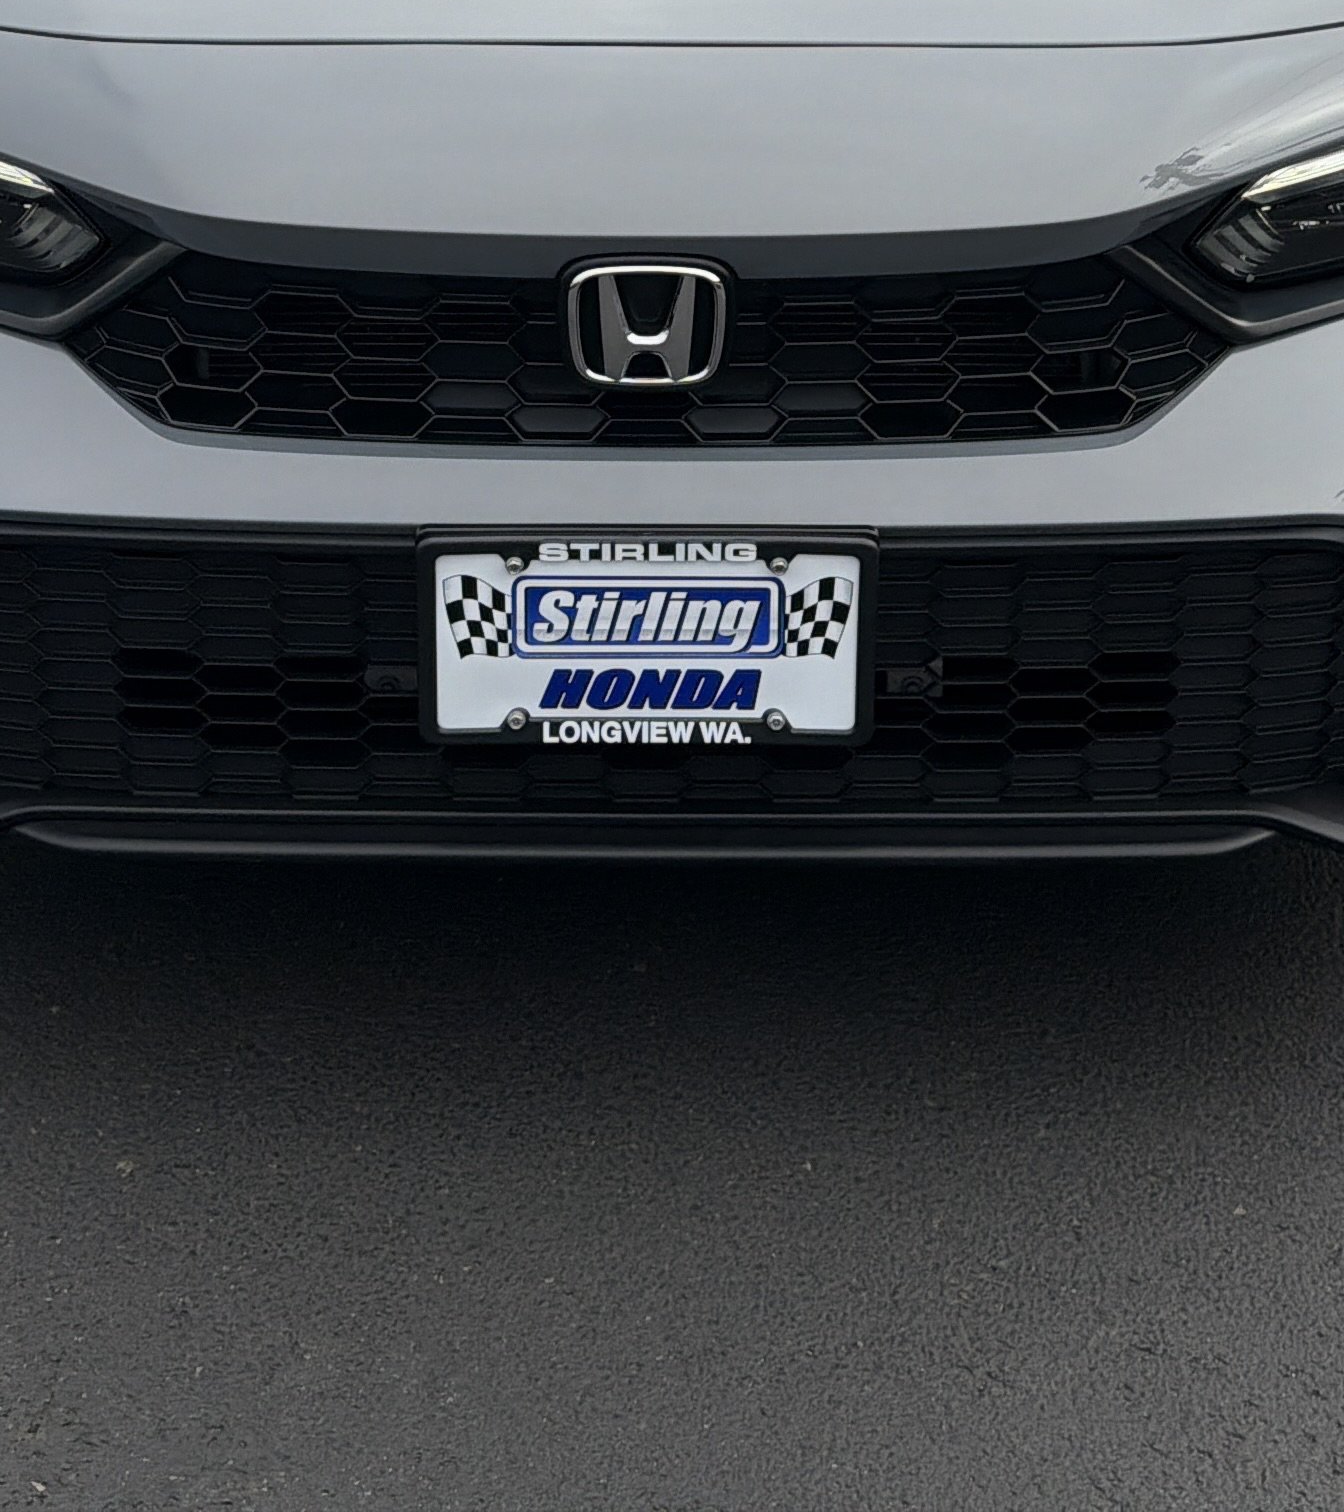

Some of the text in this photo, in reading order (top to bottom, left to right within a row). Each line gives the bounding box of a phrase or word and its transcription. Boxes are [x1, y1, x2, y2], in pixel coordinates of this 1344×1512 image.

[538, 543, 757, 562] STIRLING
[532, 590, 762, 653] Stirling
[538, 668, 762, 710] HONDA
[542, 721, 752, 744] LONGVIEW WA.
